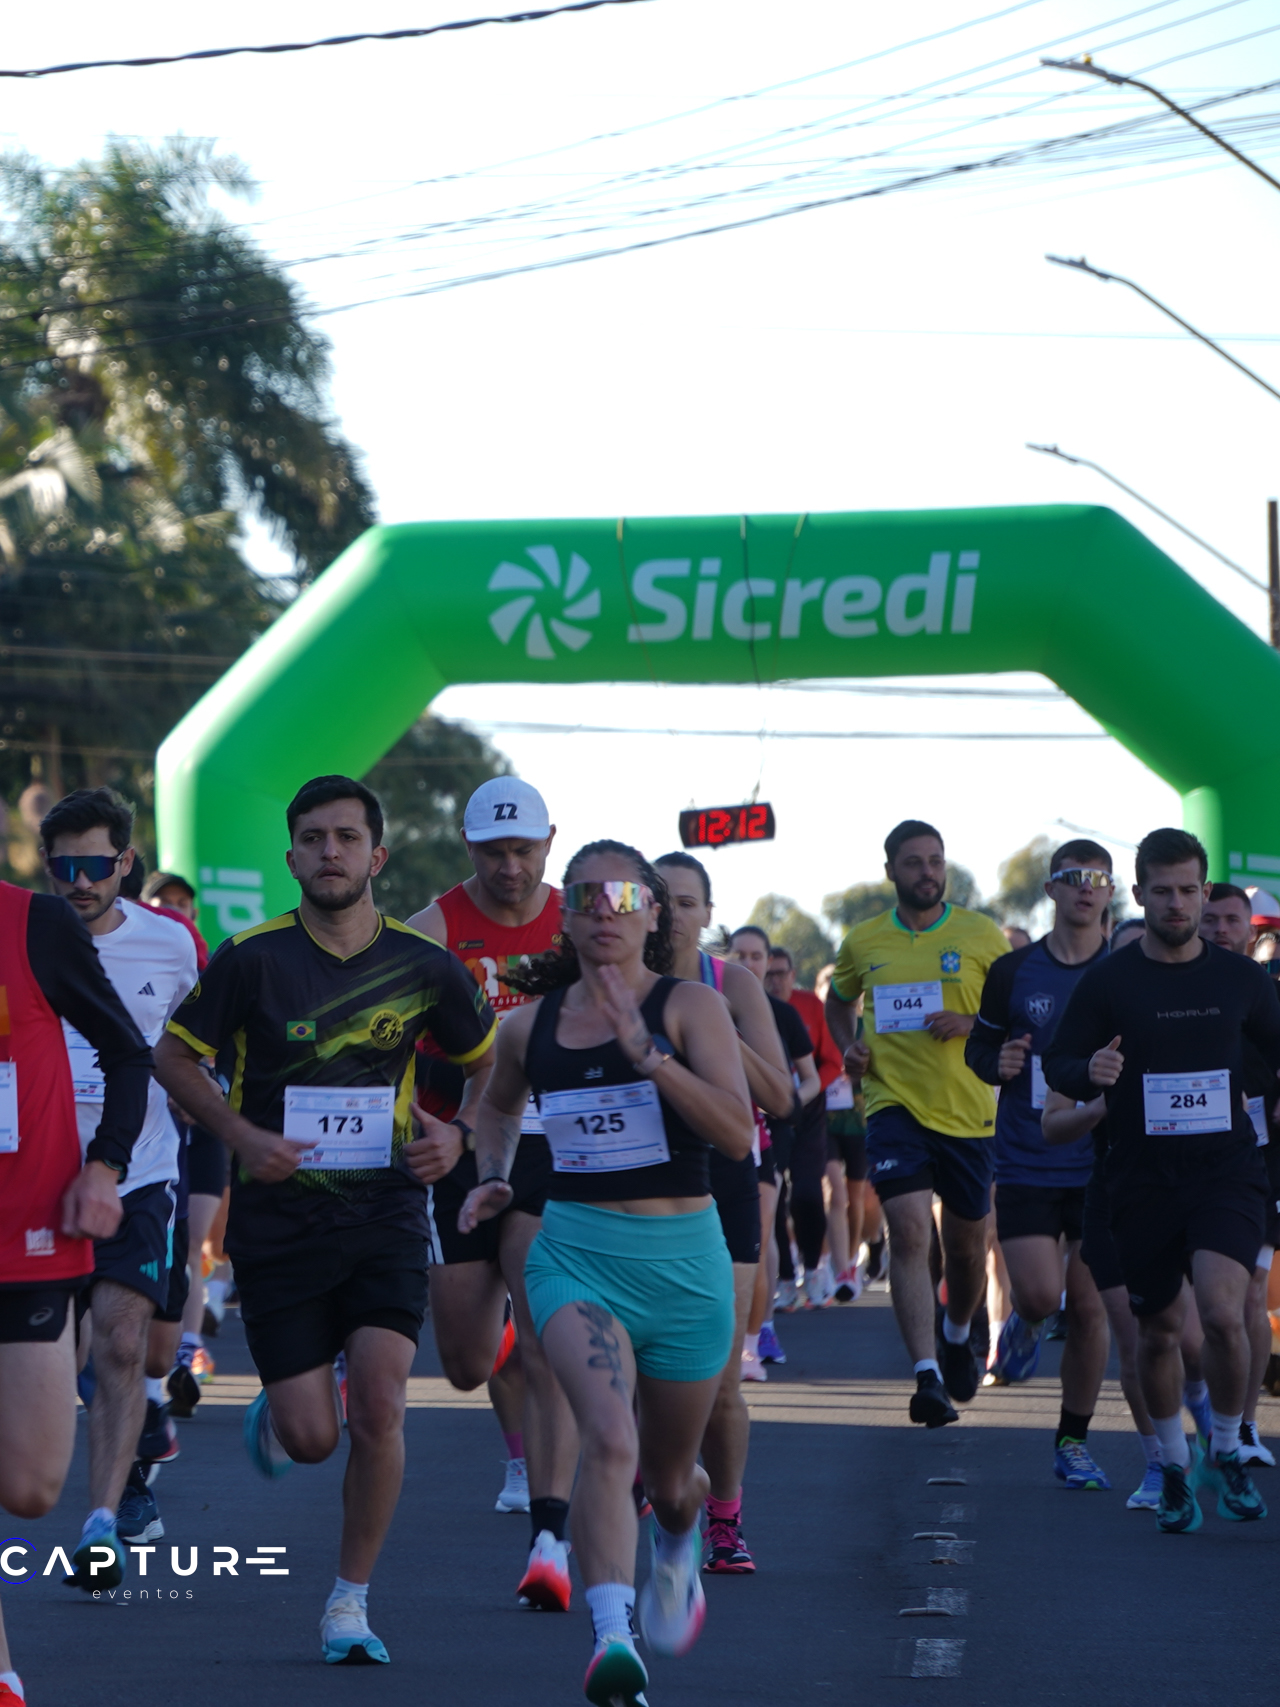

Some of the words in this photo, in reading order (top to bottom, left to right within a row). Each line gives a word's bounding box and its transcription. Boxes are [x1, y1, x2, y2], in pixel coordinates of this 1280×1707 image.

[627, 550, 981, 643] Sicredi
[698, 805, 767, 843] 12:12
[893, 997, 923, 1011] 044
[1157, 1007, 1221, 1019] HORUS
[1170, 1093, 1207, 1109] 284
[317, 1115, 364, 1135] 173
[574, 1112, 625, 1135] 125
